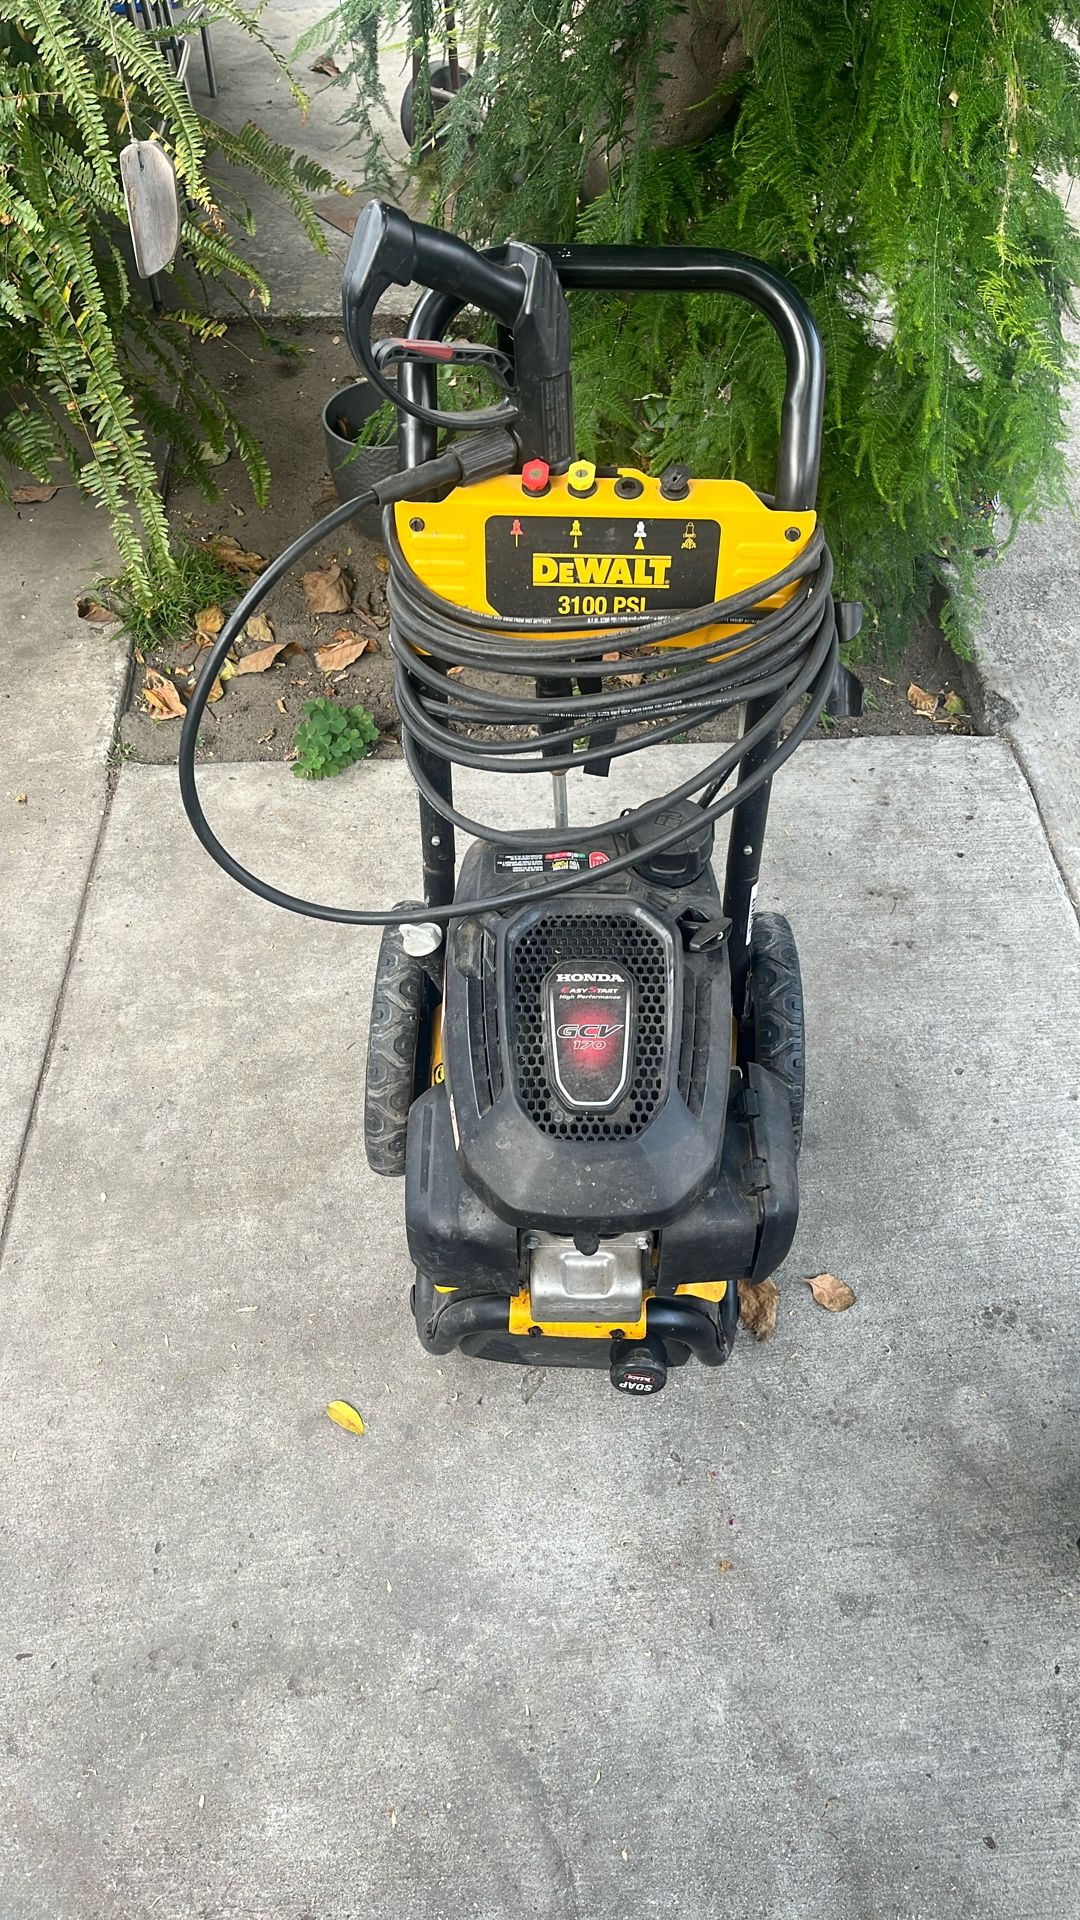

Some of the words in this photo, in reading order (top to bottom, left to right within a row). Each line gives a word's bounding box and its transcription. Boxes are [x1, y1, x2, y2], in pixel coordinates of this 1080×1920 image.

[558, 595, 608, 615] 3100
[613, 596, 646, 614] PSI
[556, 973, 625, 983] HONDA
[556, 1024, 625, 1039] GCV
[573, 1040, 607, 1050] 170
[619, 1381, 653, 1391] SOAP
